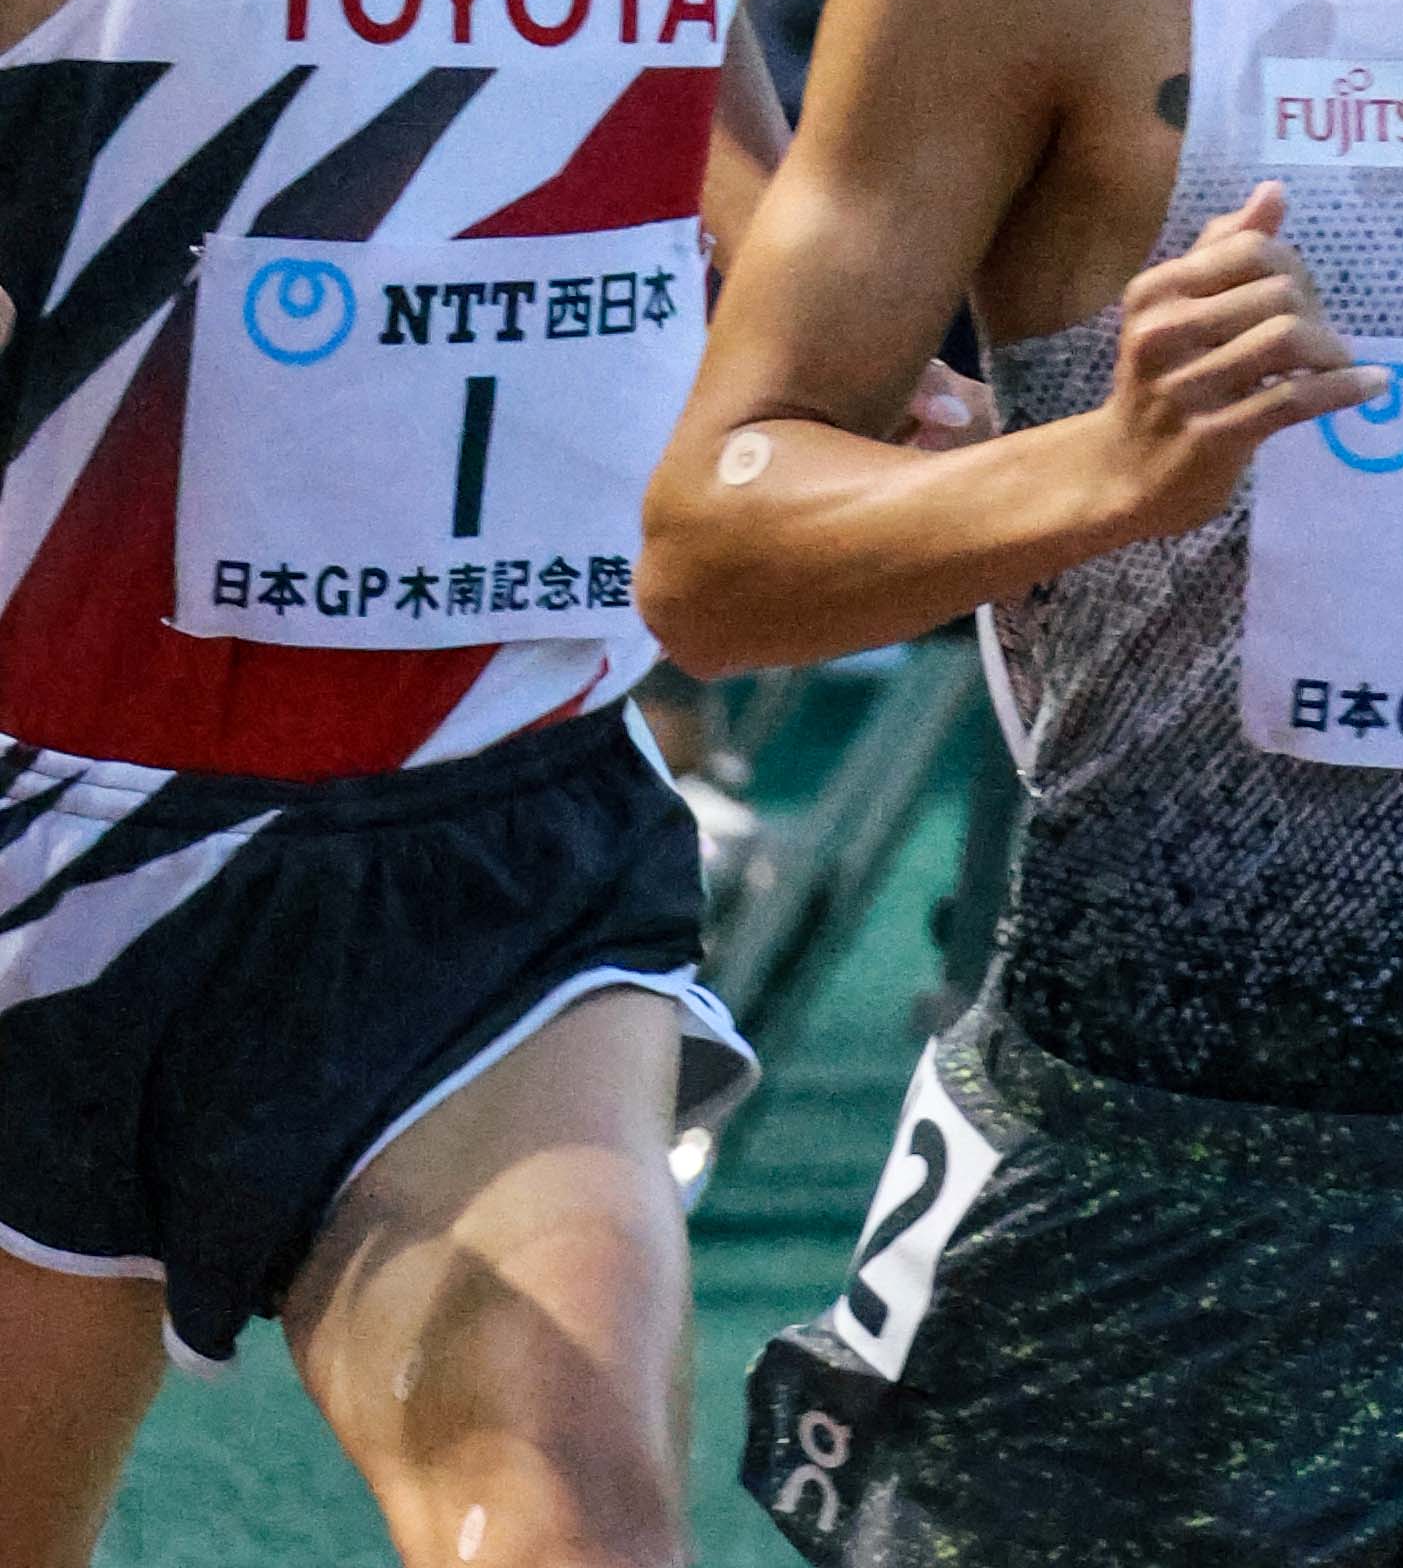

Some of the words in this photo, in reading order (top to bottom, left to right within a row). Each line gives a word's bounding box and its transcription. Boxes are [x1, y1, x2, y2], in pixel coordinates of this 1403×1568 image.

[379, 266, 678, 344] NTT西日本
[848, 1118, 947, 1337] 2
